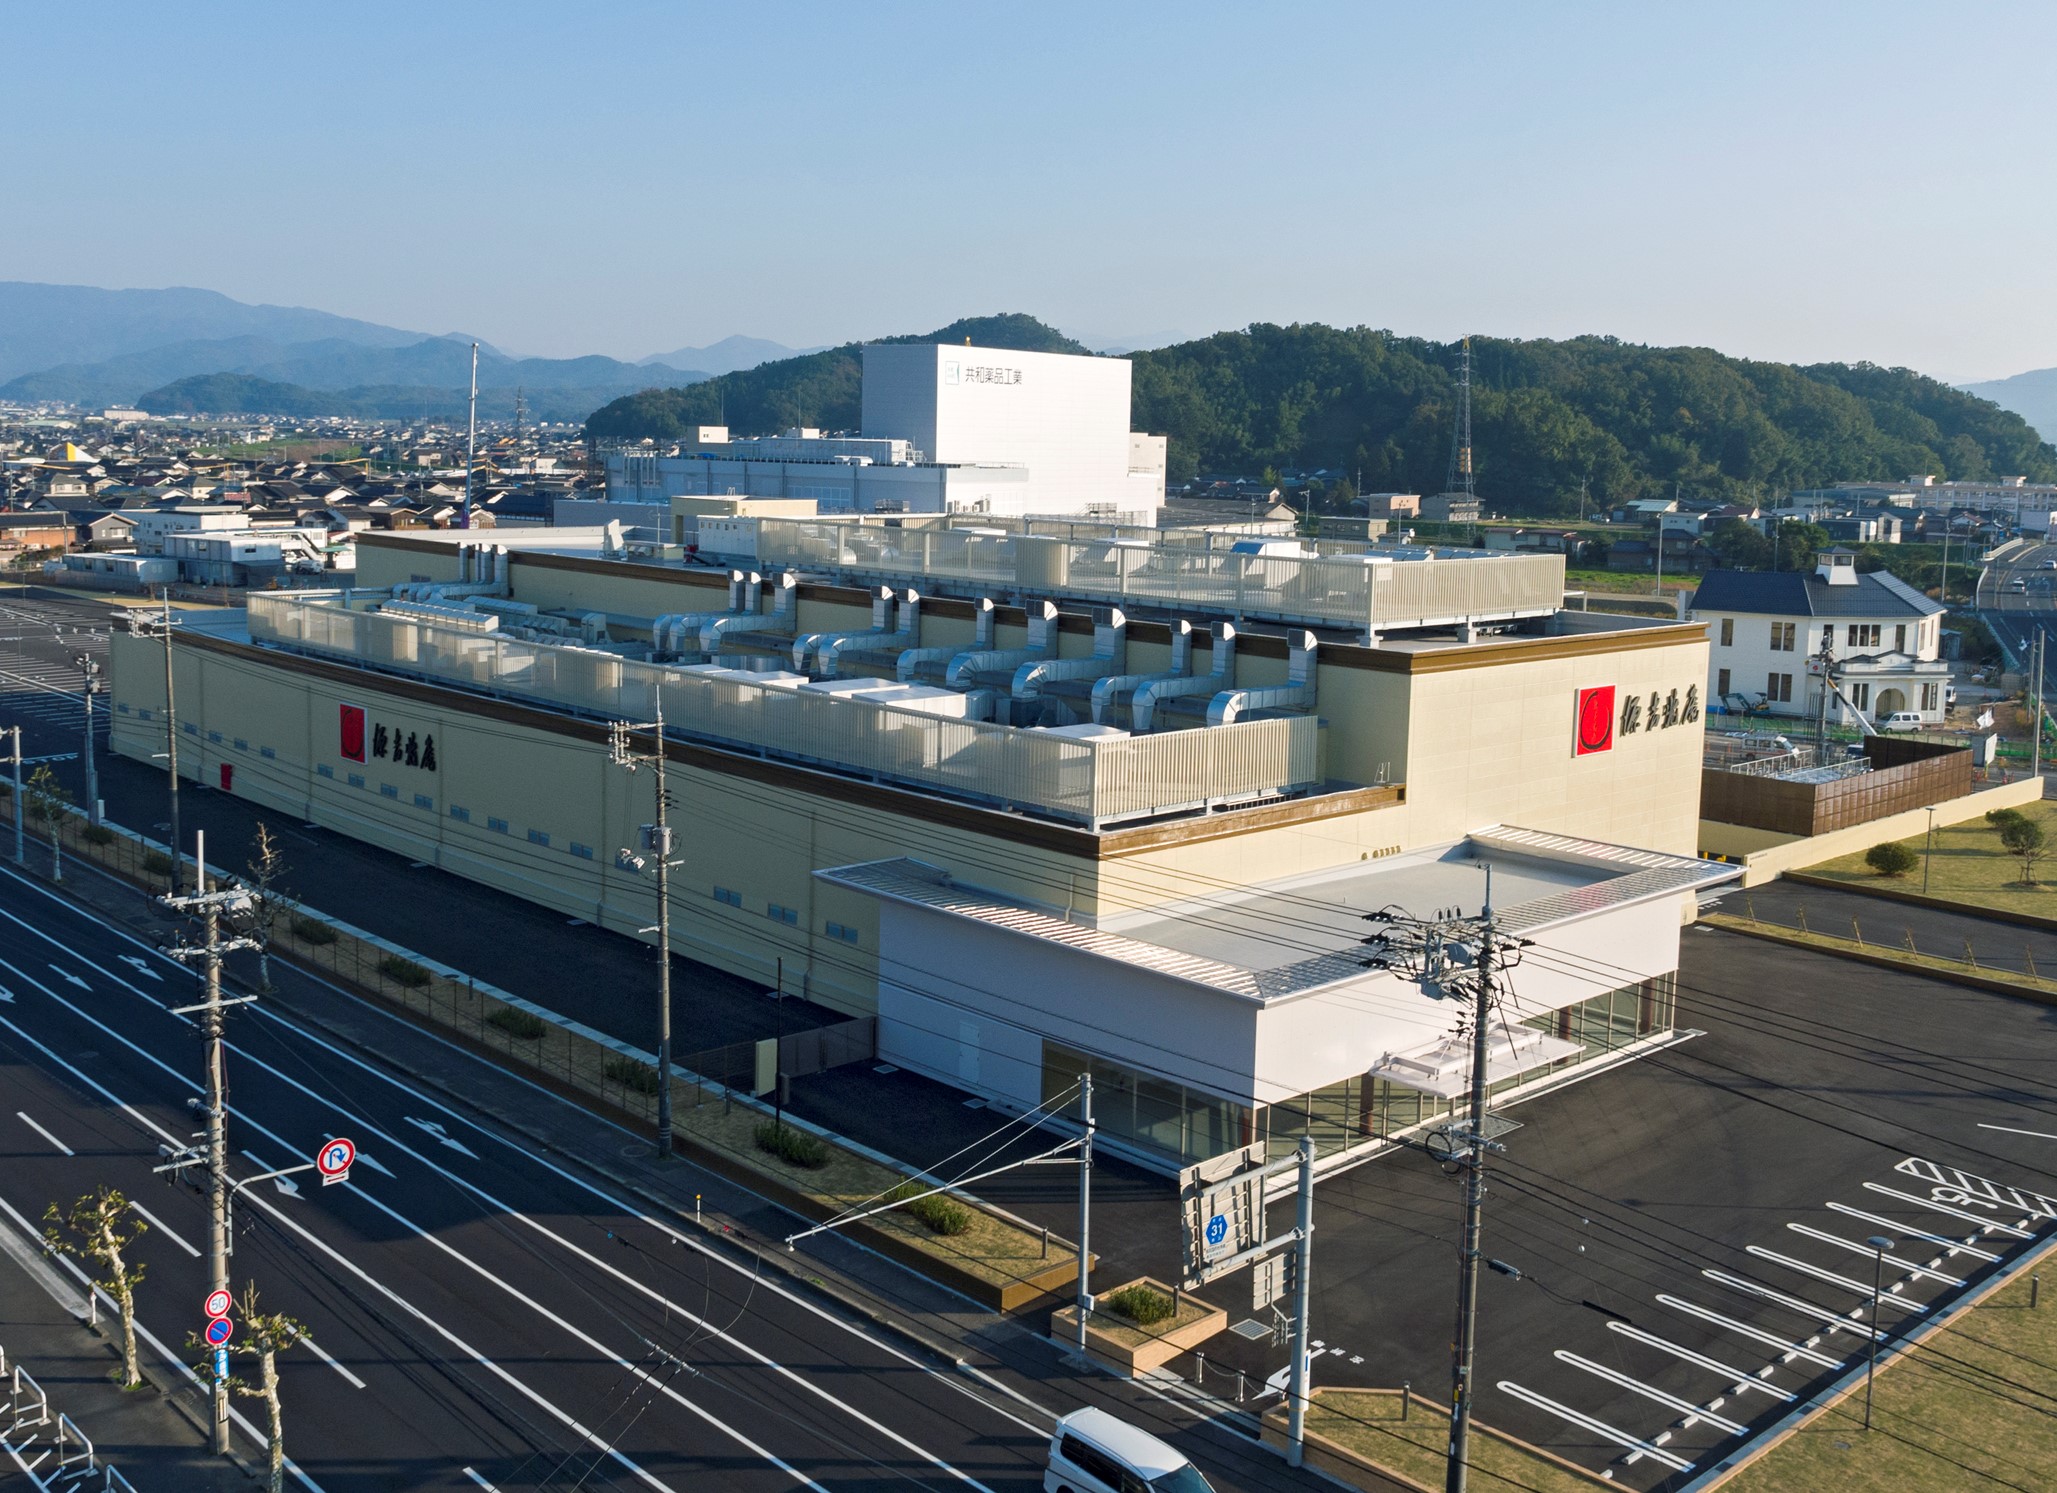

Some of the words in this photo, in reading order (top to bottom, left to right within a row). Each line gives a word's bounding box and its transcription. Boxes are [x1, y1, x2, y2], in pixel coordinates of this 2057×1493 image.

[965, 366, 1022, 385] 共和薬品工業
[1211, 1222, 1223, 1236] 31
[211, 1296, 225, 1311] 50
